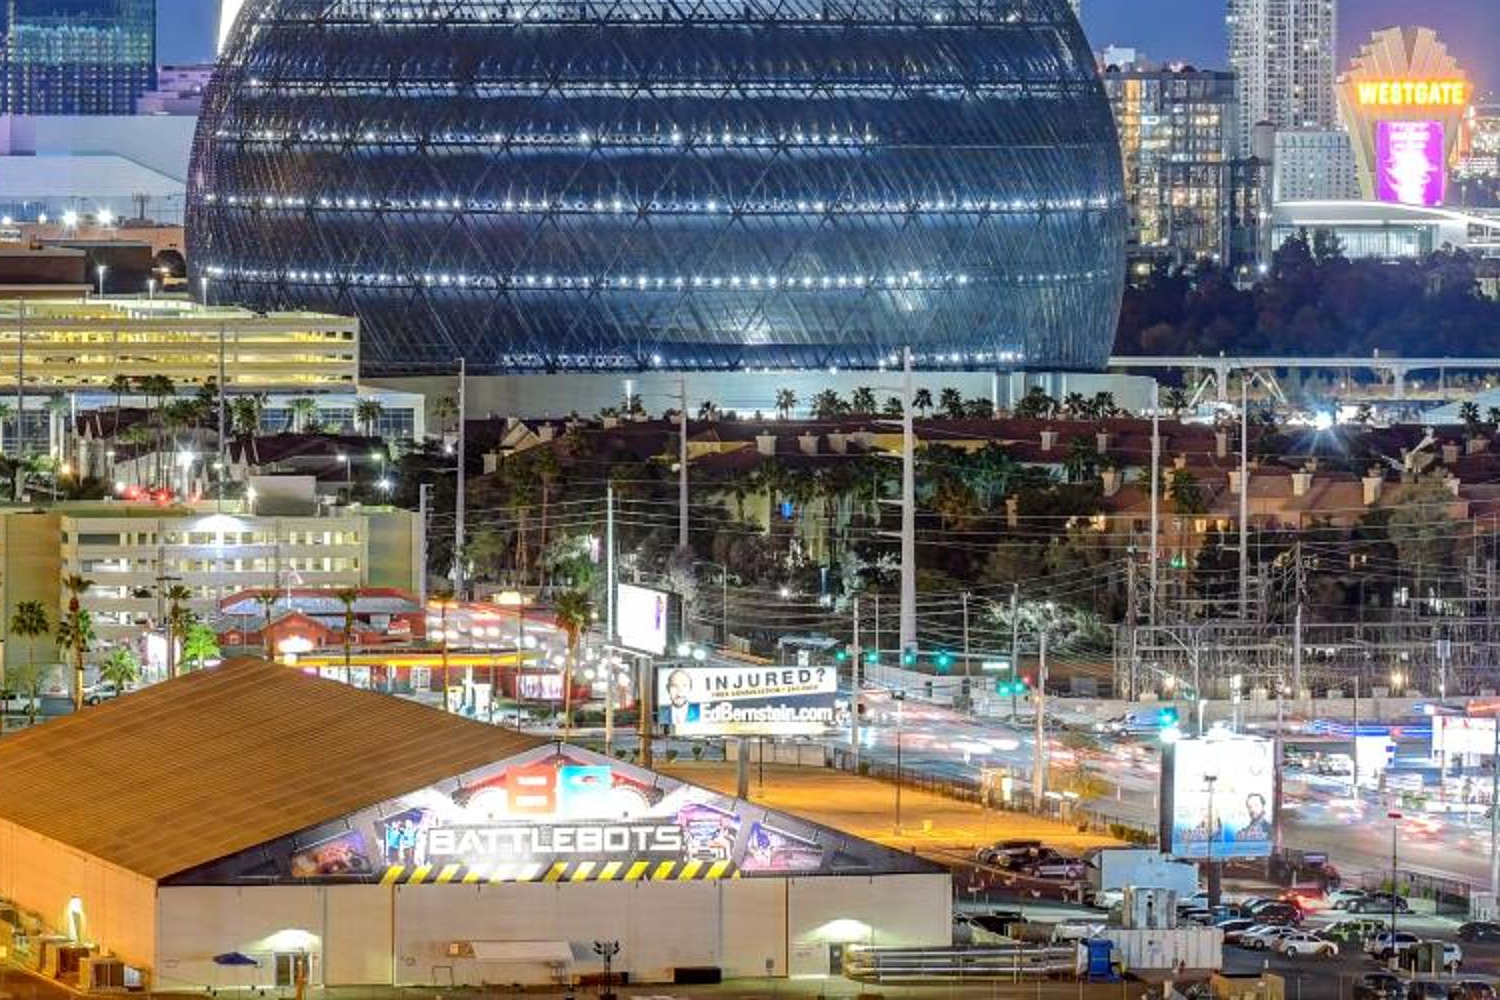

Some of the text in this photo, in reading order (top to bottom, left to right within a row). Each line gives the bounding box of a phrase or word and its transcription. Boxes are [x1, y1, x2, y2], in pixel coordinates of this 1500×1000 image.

[1357, 81, 1465, 105] WESTGATE
[705, 667, 826, 691] INJURED?
[428, 826, 682, 855] BATTLEBOTS
